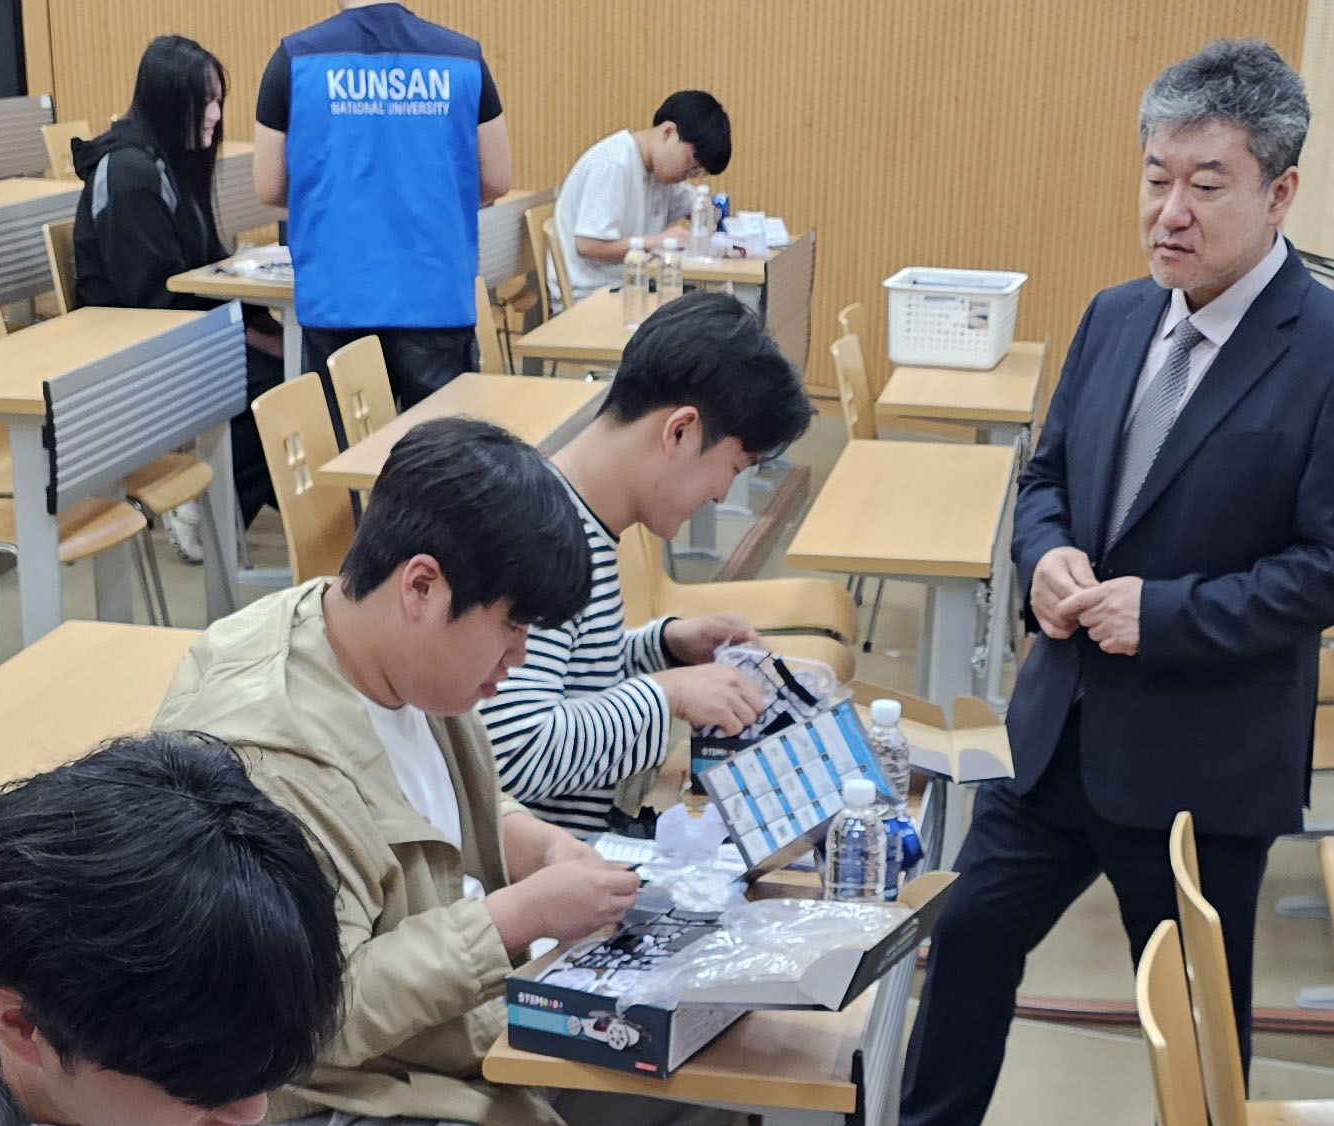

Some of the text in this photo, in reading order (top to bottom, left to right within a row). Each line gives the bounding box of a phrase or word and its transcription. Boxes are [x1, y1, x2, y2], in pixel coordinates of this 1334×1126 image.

[327, 68, 451, 100] KUNSAN
[330, 101, 450, 116] NATIONAL UNIVERSITY
